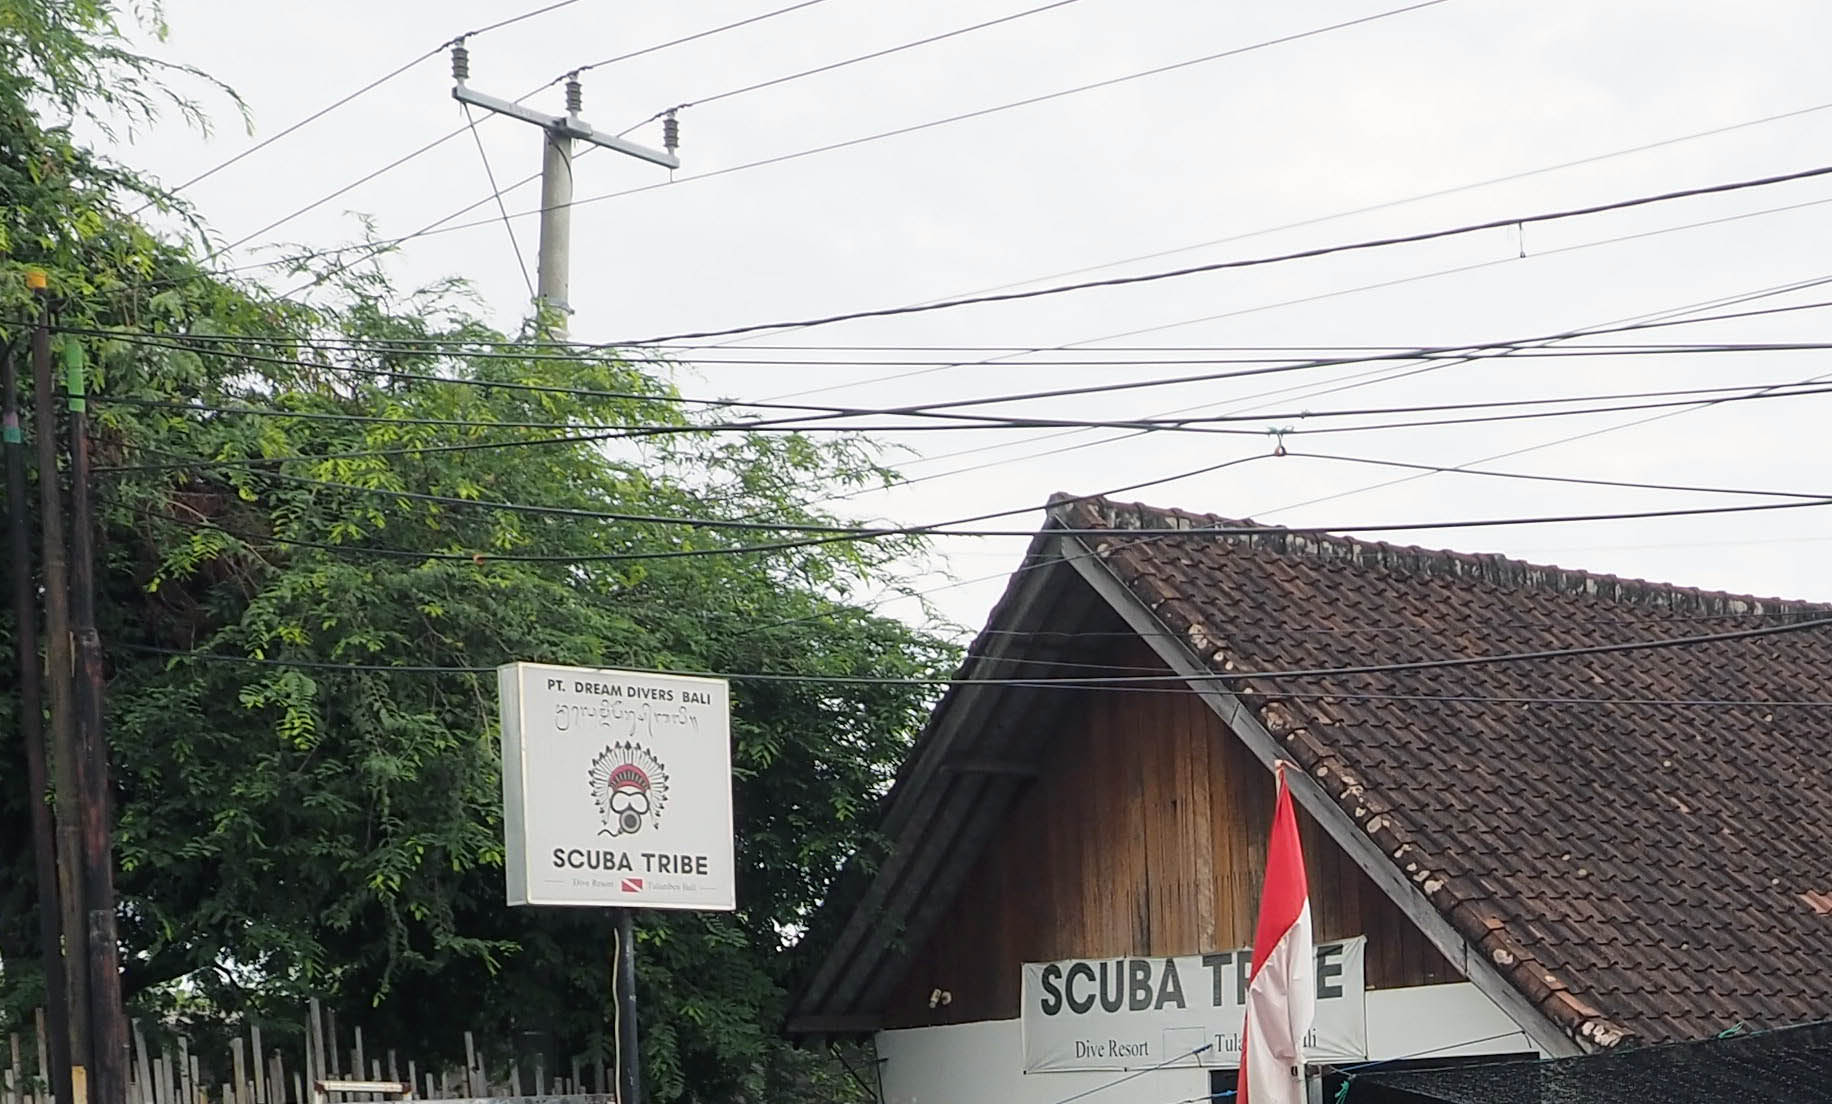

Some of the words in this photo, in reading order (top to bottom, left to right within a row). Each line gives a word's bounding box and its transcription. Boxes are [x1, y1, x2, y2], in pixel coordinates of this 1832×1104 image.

[548, 678, 567, 693] PT.
[574, 681, 623, 698] DREAM
[627, 684, 674, 702] DIVERS
[682, 690, 711, 705] BALI
[553, 848, 633, 872] SCUBA
[641, 853, 709, 875] TRIBE
[1040, 958, 1187, 1016] SCUBA
[1202, 944, 1343, 1008] TRE
[1075, 1039, 1105, 1059] Dive
[1108, 1038, 1149, 1058] Resort
